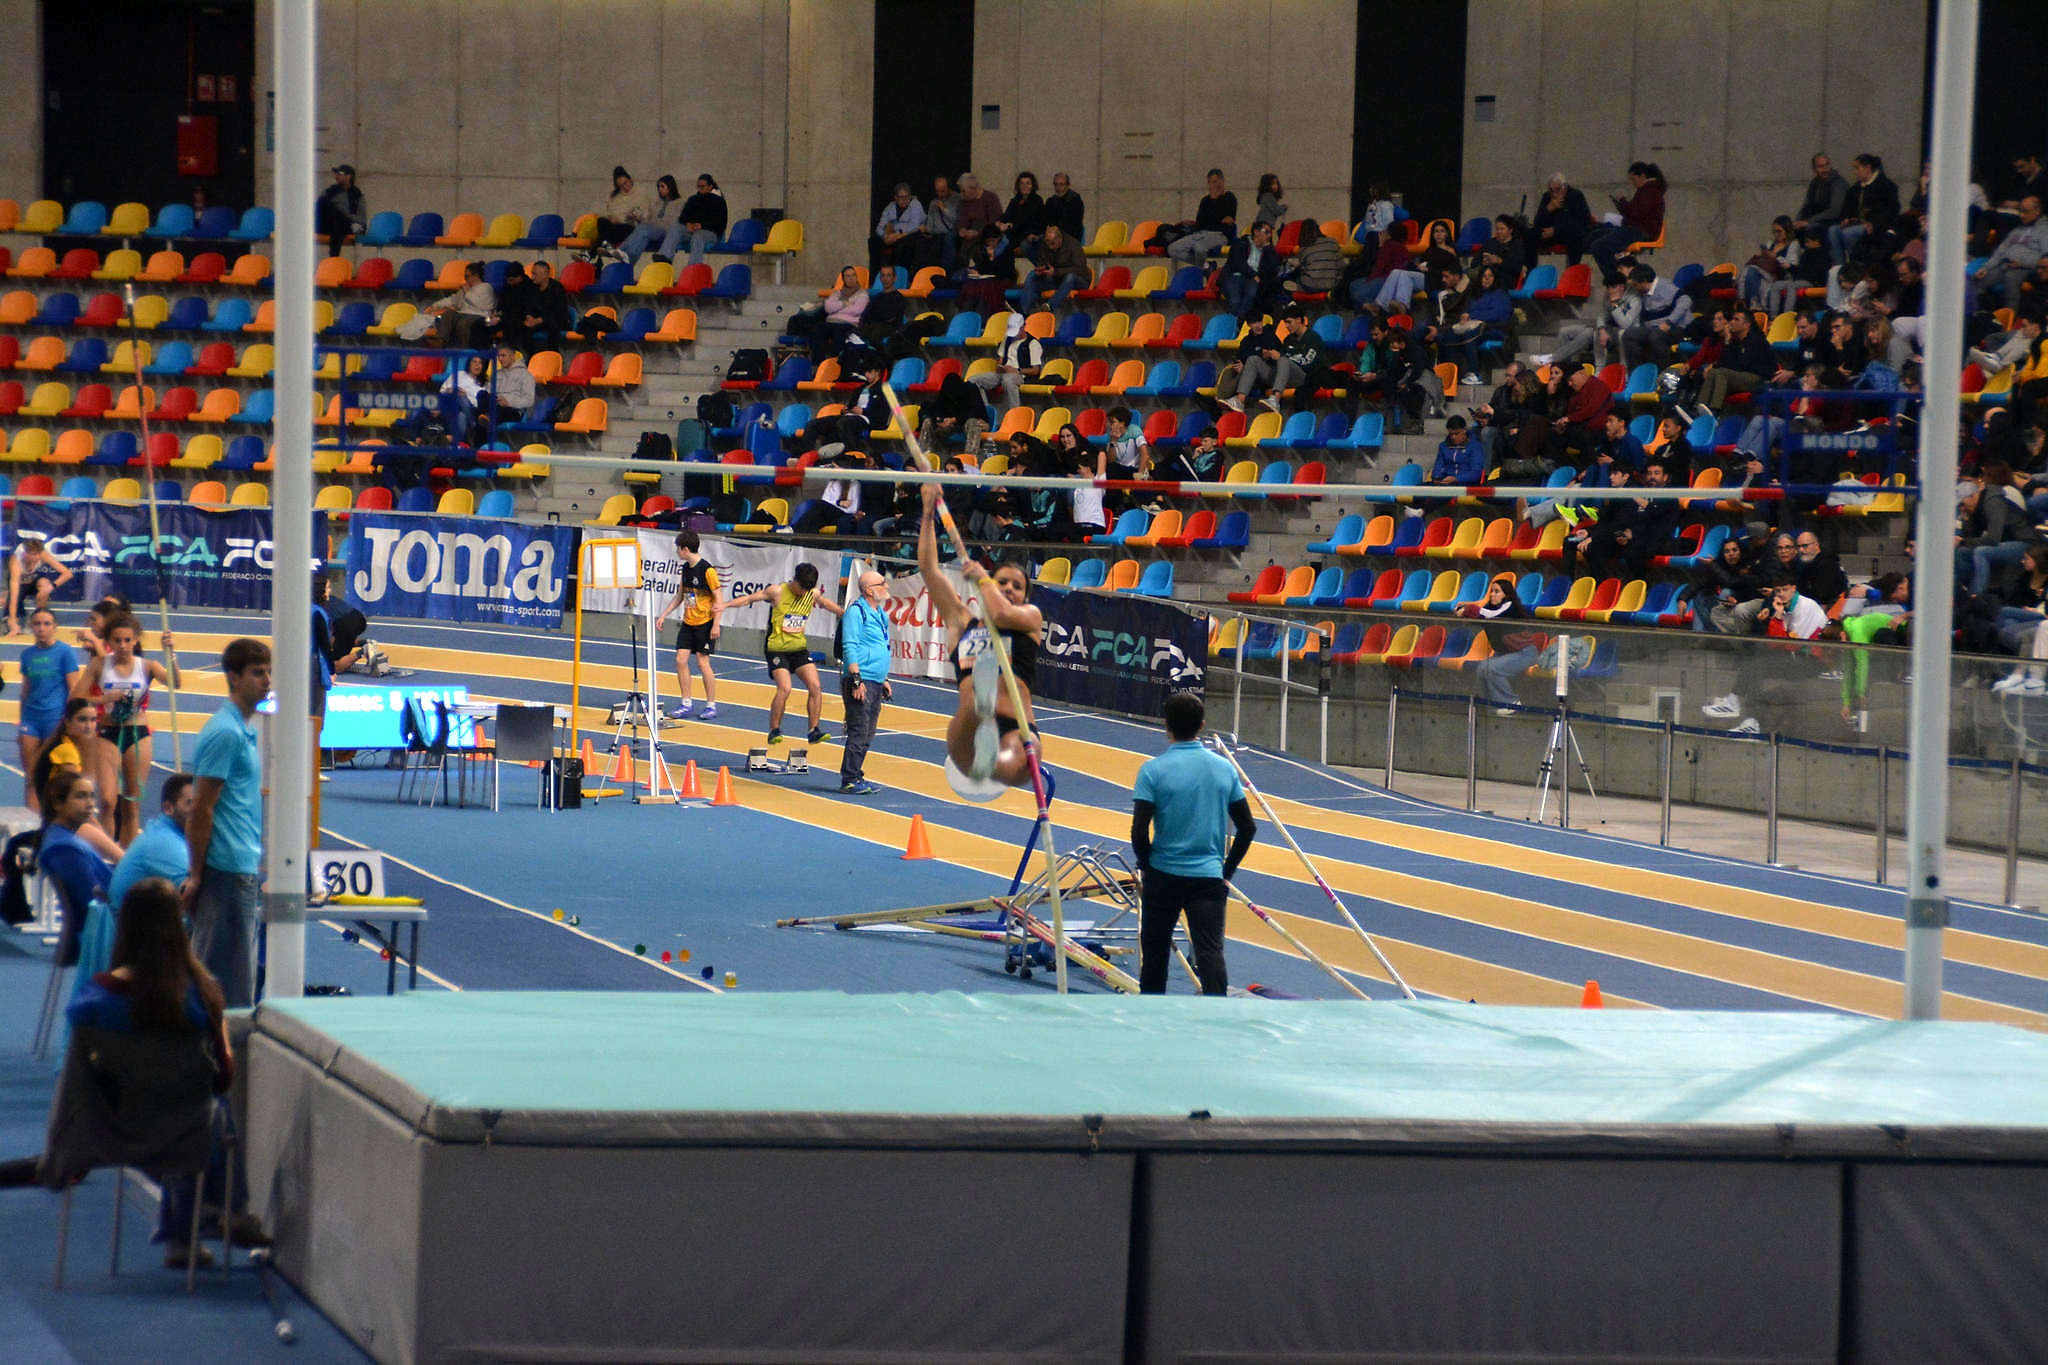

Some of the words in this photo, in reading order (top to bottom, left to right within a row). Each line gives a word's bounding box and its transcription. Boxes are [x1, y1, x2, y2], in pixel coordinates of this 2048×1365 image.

[358, 393, 438, 409] MONDO
[1802, 434, 1878, 449] MONDO
[115, 535, 219, 567] FCA
[1092, 628, 1149, 669] FCA
